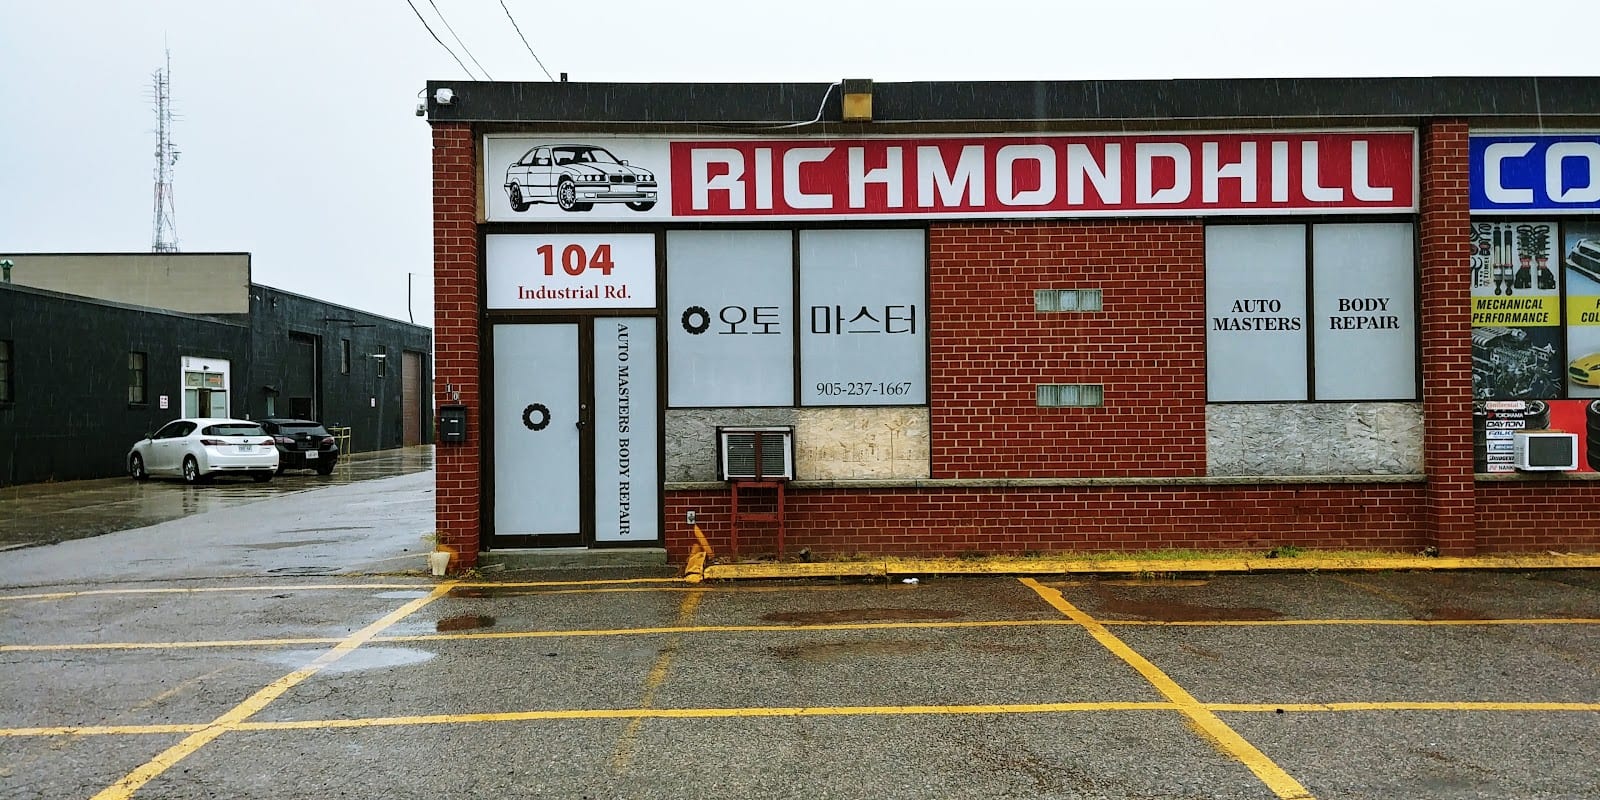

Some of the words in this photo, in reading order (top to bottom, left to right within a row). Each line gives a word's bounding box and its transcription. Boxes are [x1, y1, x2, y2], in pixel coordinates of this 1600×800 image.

[691, 141, 1393, 210] RICHMONDHILL
[536, 244, 615, 276] 104
[518, 285, 599, 300] Industrial
[604, 284, 631, 299] Rd.
[1232, 299, 1281, 313] AUTO
[1338, 298, 1390, 312] BODY
[1477, 299, 1543, 310] MECHANICAL
[718, 305, 782, 335] 오토
[811, 304, 916, 335] 마스터
[1213, 317, 1301, 331] MASTERS
[1329, 315, 1400, 330] REPAIR
[1472, 312, 1549, 323] PERFORMANCE
[617, 324, 629, 362] AUTO
[816, 382, 912, 396] 905-237-1667
[618, 366, 630, 433] MASTERS
[619, 439, 630, 478] BODY
[619, 482, 631, 536] REPAIR
